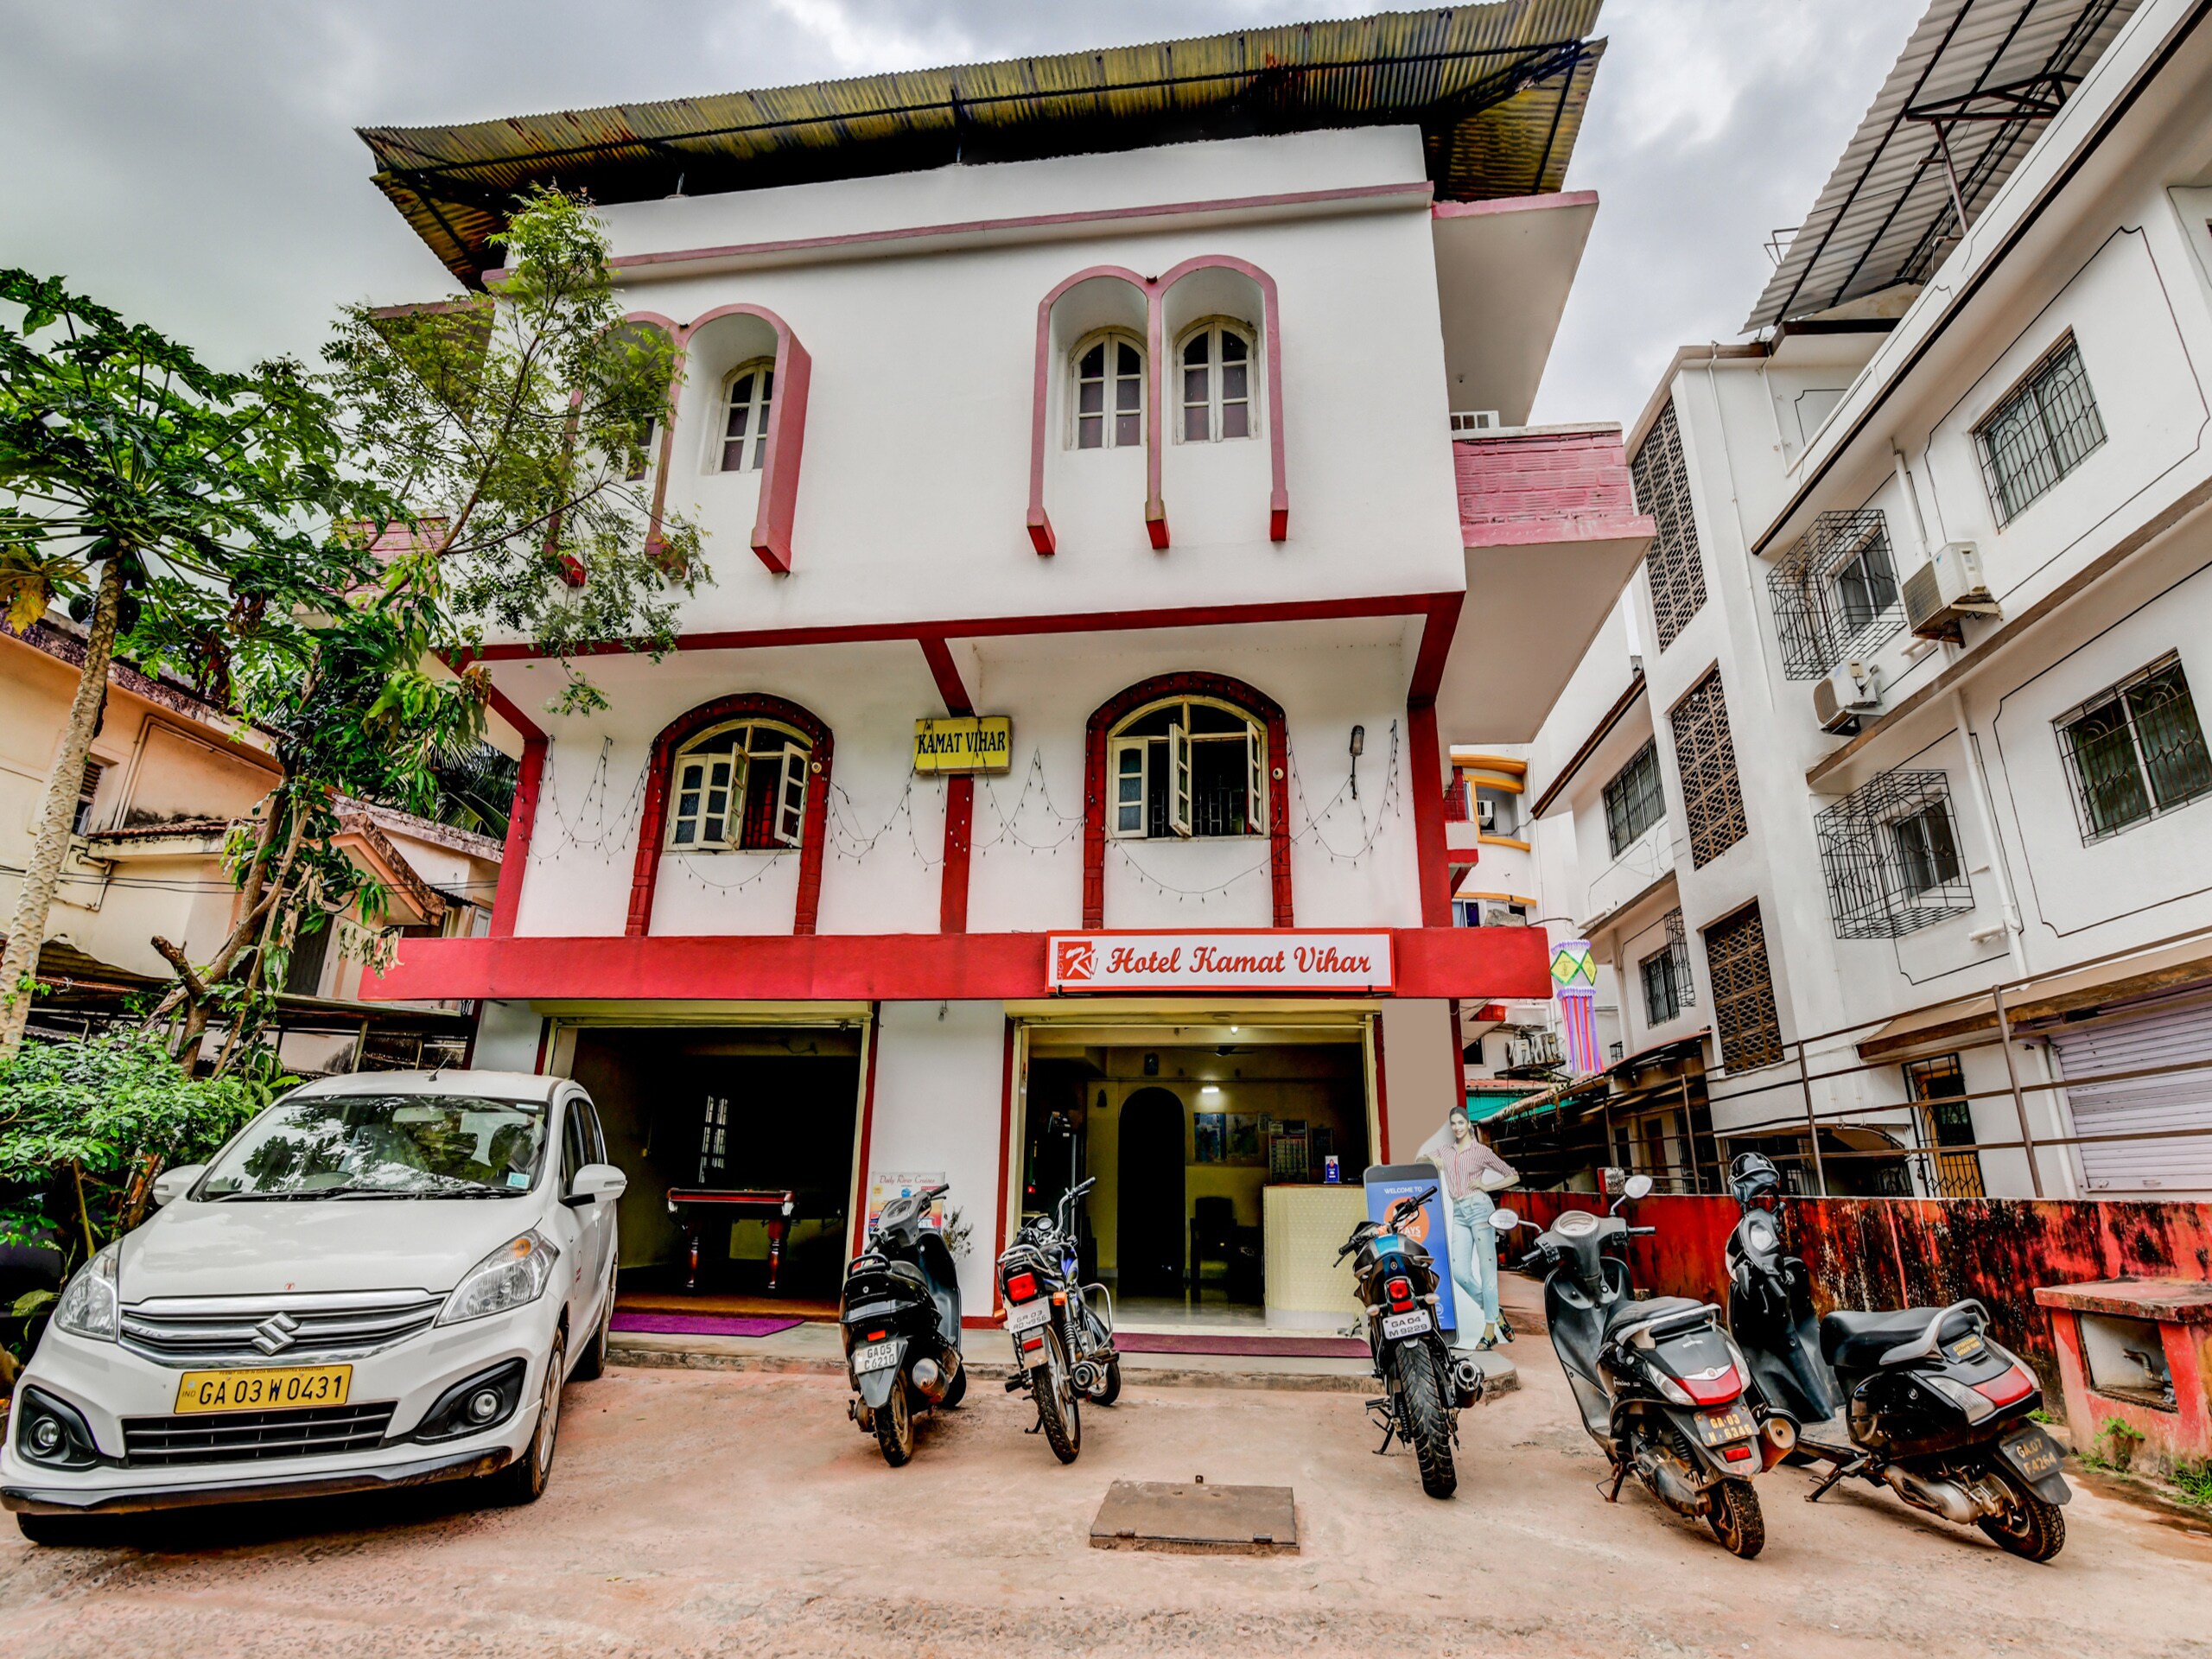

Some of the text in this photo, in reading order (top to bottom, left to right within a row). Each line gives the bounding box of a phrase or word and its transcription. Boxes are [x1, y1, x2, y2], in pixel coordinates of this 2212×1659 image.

[918, 731, 1006, 754] KAMAT VIHAR
[1106, 946, 1372, 973] Hotel Kamat Vihar
[199, 1376, 342, 1405] GA 03 W 0431
